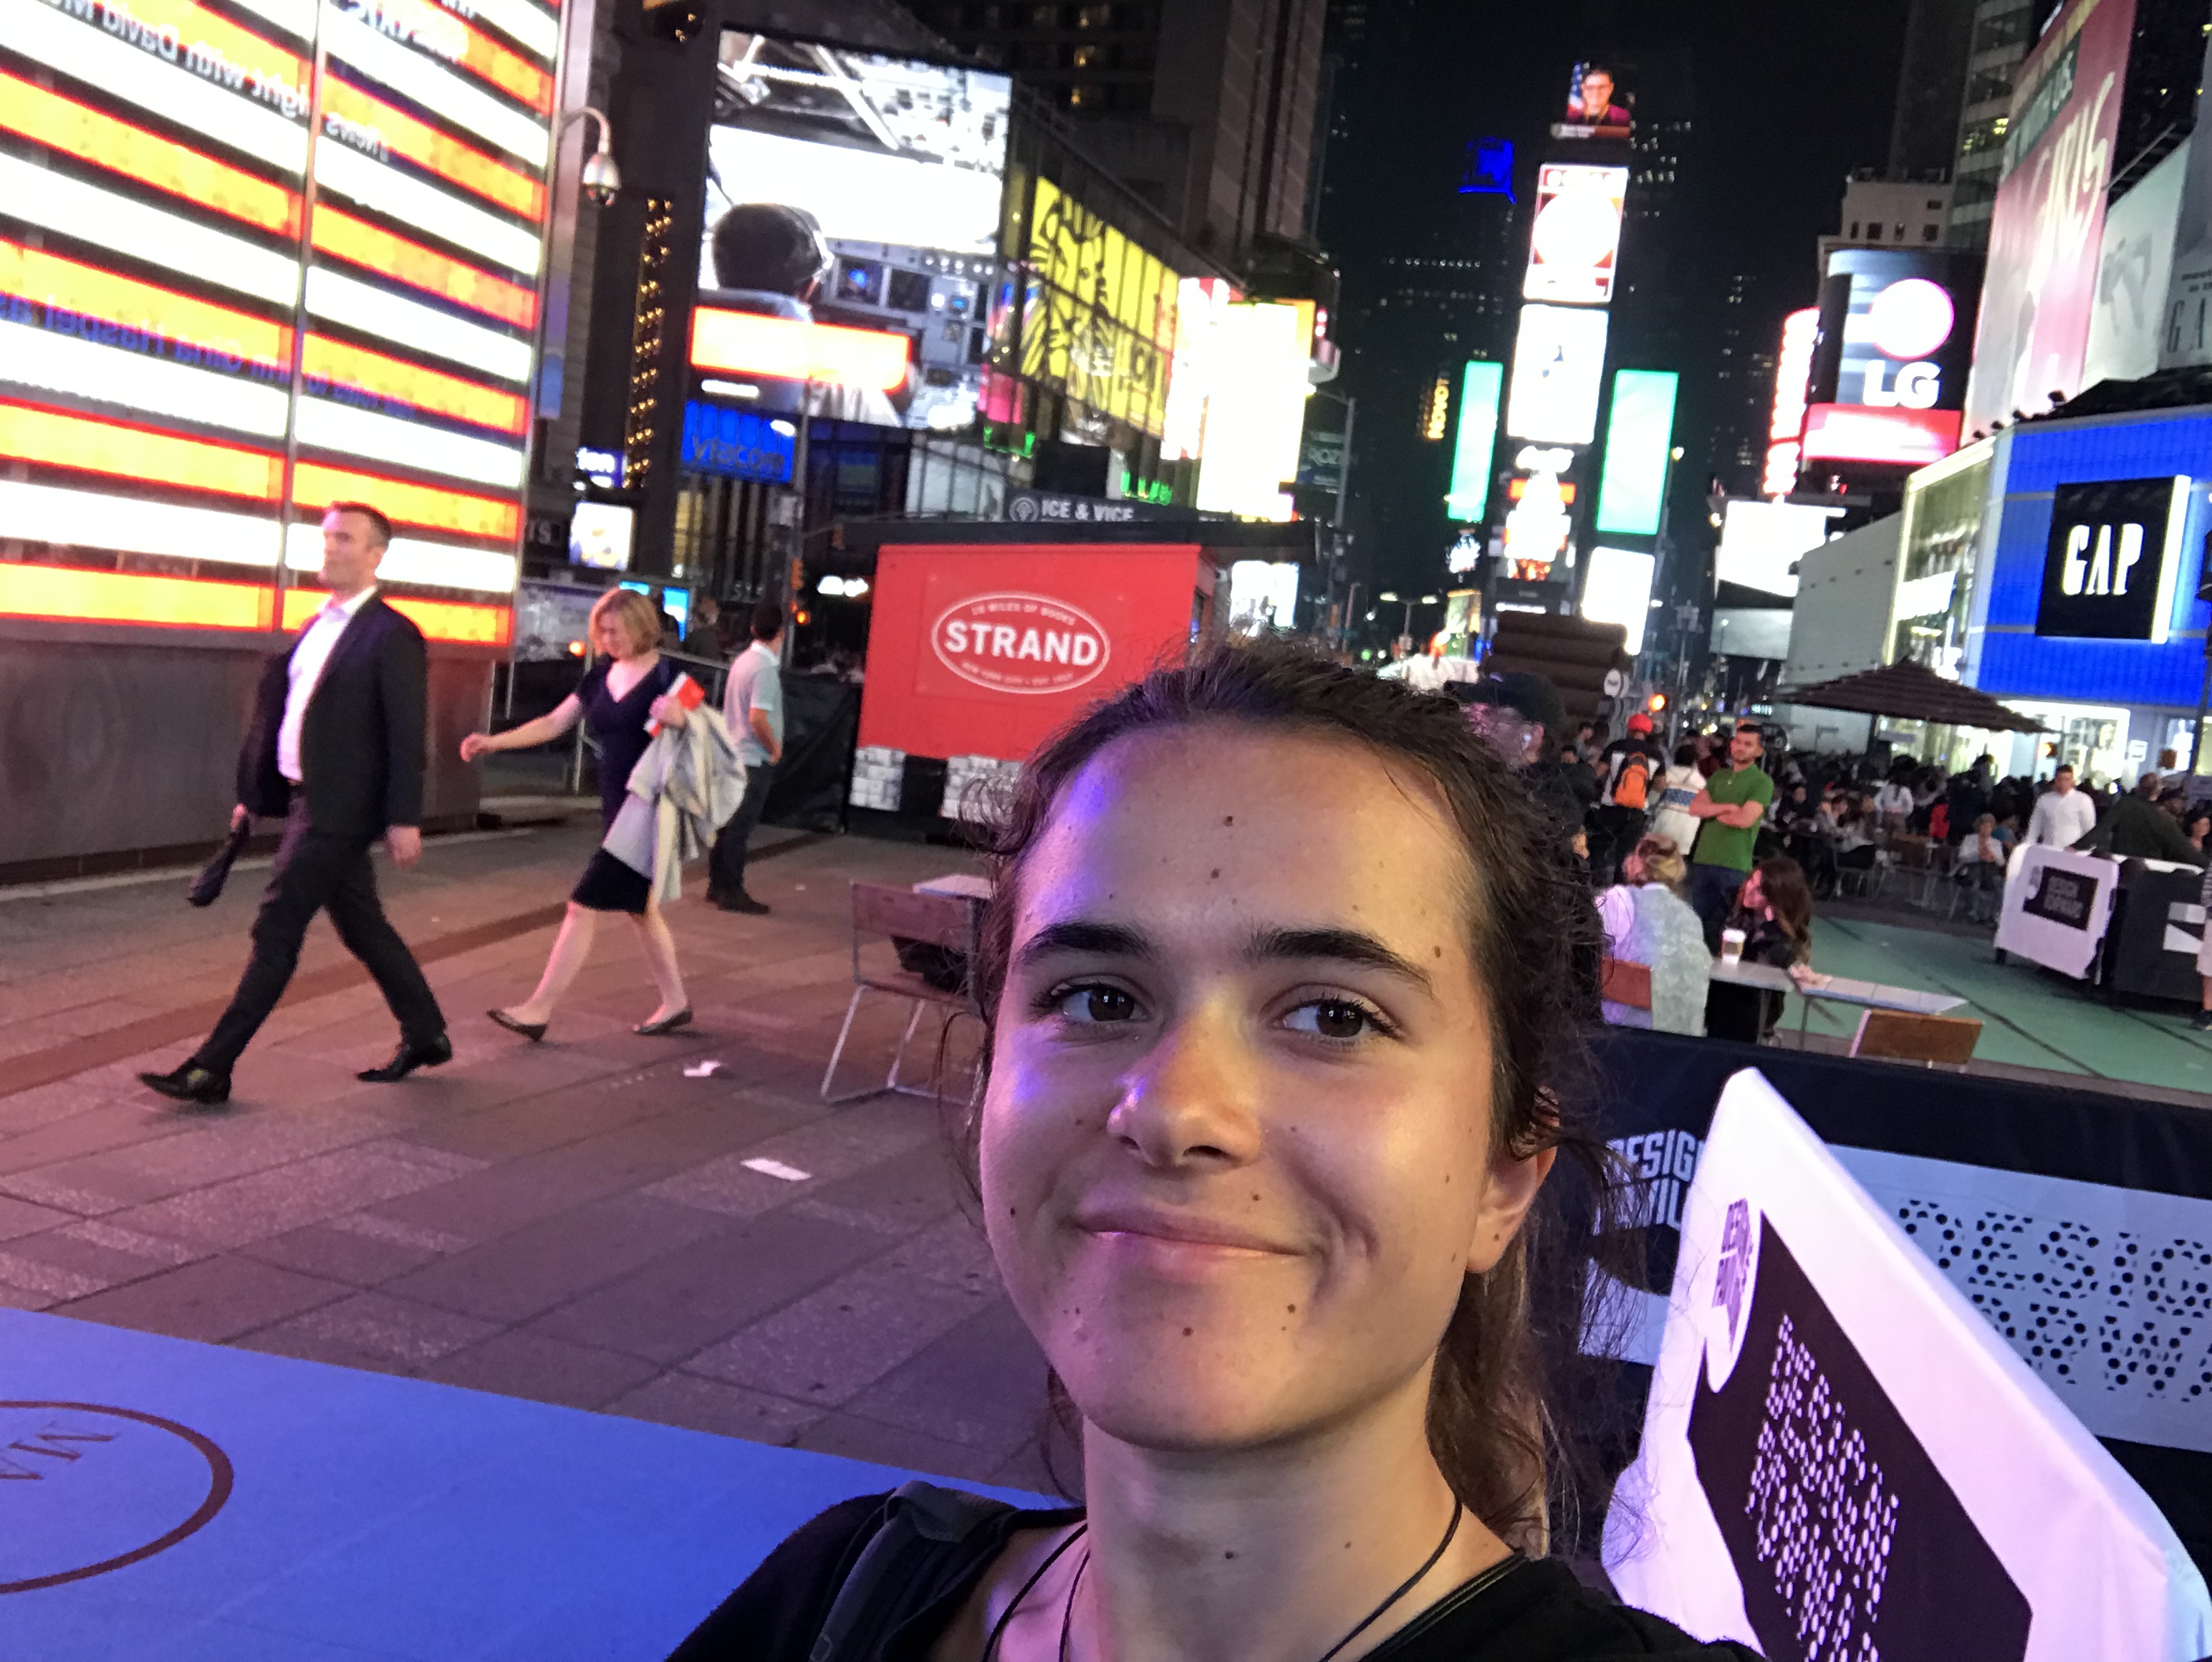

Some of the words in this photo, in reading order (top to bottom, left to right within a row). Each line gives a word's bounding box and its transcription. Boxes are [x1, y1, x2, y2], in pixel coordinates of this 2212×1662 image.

[1862, 360, 1942, 409] LG
[1042, 500, 1072, 519] ICE
[1074, 504, 1090, 521] &
[1093, 504, 1134, 522] VICE
[2062, 523, 2145, 596] GAP
[944, 619, 1099, 666] STRAND
